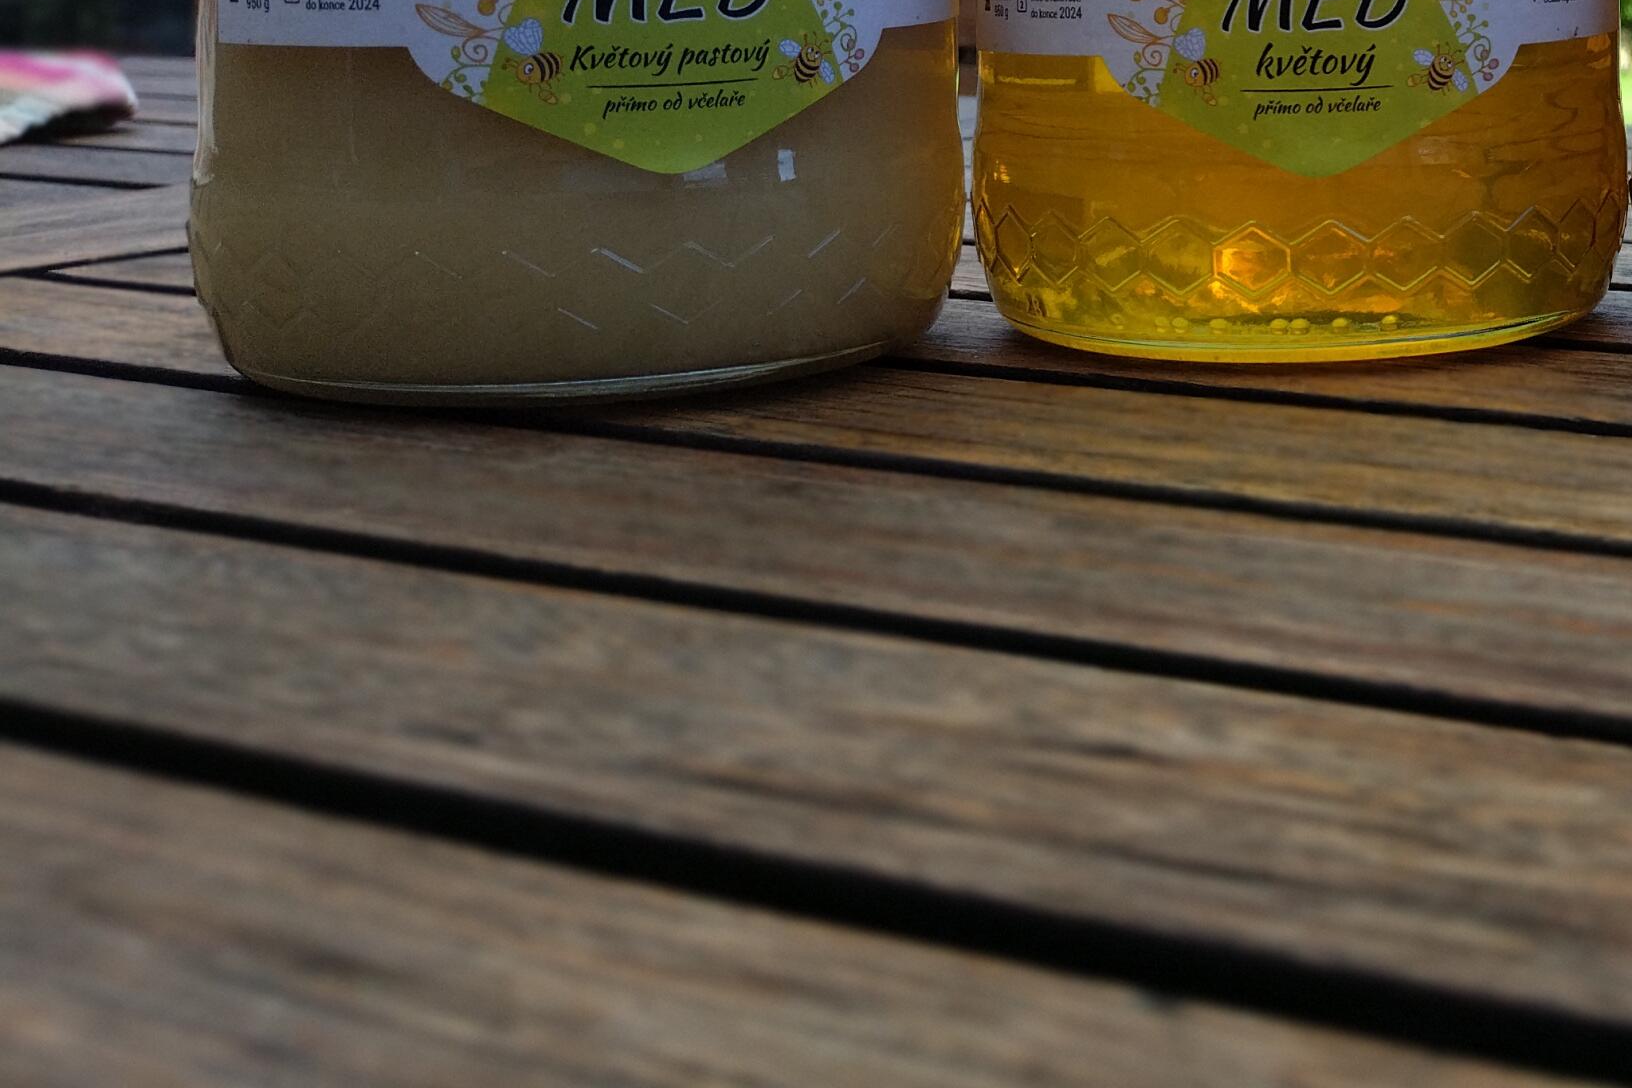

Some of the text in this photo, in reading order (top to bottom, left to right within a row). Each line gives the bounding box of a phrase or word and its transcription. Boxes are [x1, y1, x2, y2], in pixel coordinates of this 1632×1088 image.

[264, 0, 270, 12] g
[1059, 7, 1082, 19] 2024
[569, 39, 771, 76] Květový pastový
[1255, 42, 1376, 86] květový
[602, 88, 746, 119] přímo od včelaře
[1253, 95, 1382, 120] přímo od včelaře
